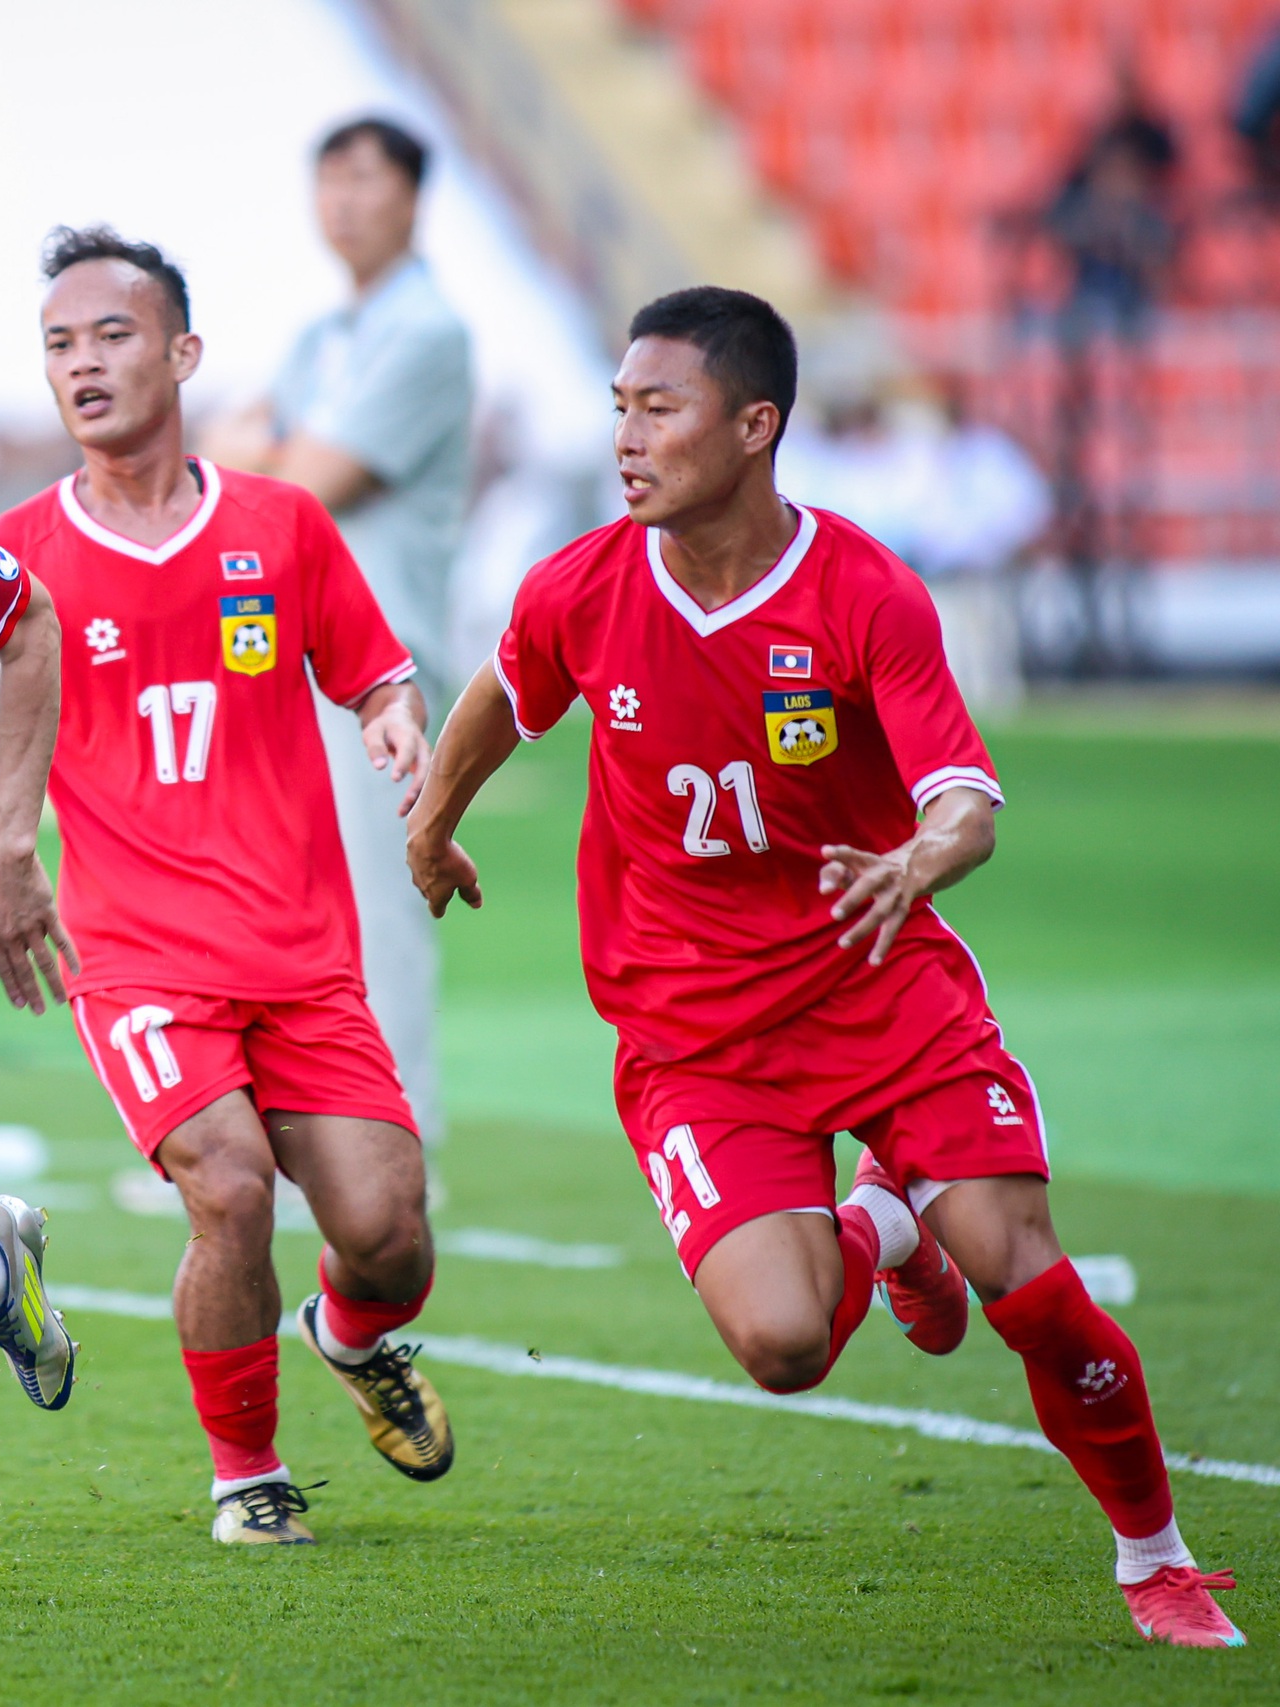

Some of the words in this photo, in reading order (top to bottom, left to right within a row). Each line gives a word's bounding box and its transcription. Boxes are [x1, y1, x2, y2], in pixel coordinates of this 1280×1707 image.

[137, 681, 217, 784] 17
[784, 694, 812, 709] LAOS
[666, 760, 770, 857] 21
[110, 1004, 182, 1103] 17
[647, 1123, 722, 1249] 21
